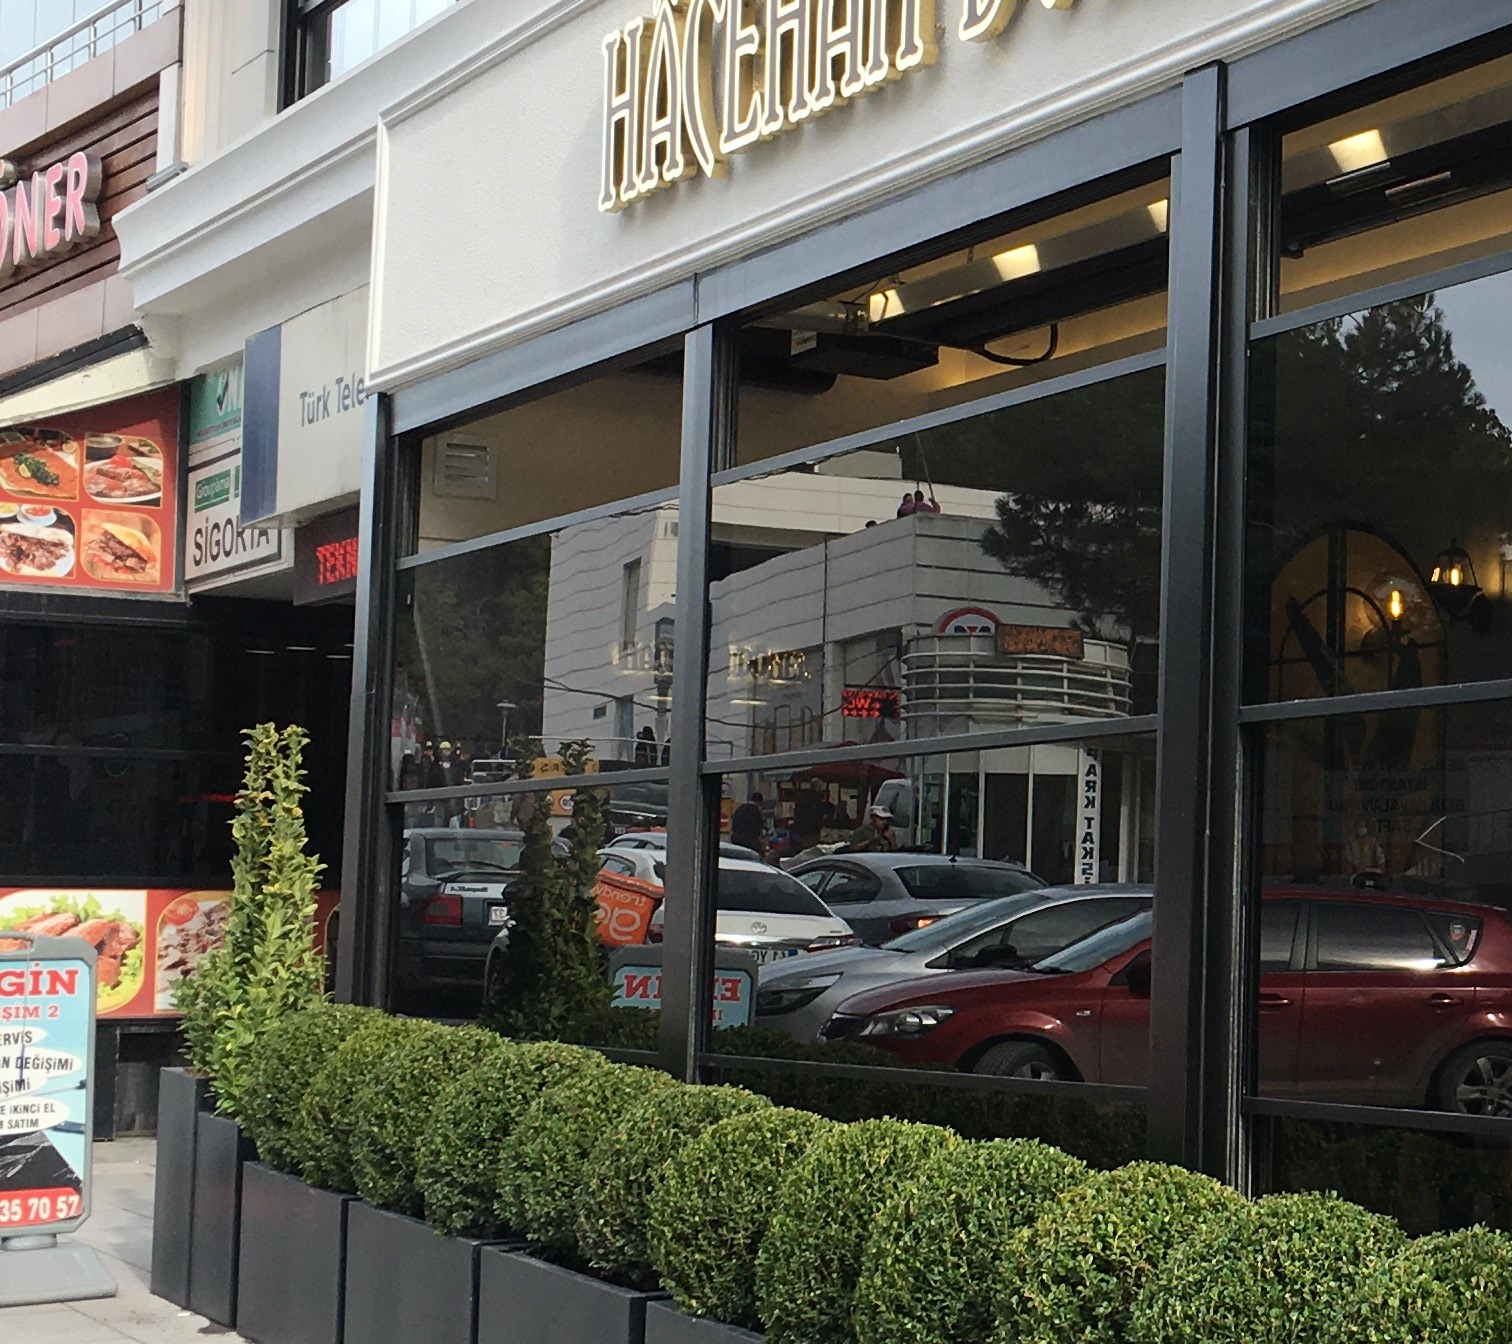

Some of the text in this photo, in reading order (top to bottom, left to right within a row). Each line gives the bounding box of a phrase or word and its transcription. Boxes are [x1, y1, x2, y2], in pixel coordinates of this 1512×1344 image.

[299, 374, 370, 428] Türk Tele
[47, 1005, 59, 1019] 2
[15, 1053, 74, 1074] DEĞİŞİMİ
[44, 1102, 56, 1113] EL
[7, 1118, 39, 1129] SATIM
[0, 1195, 80, 1222] 35 70 57
